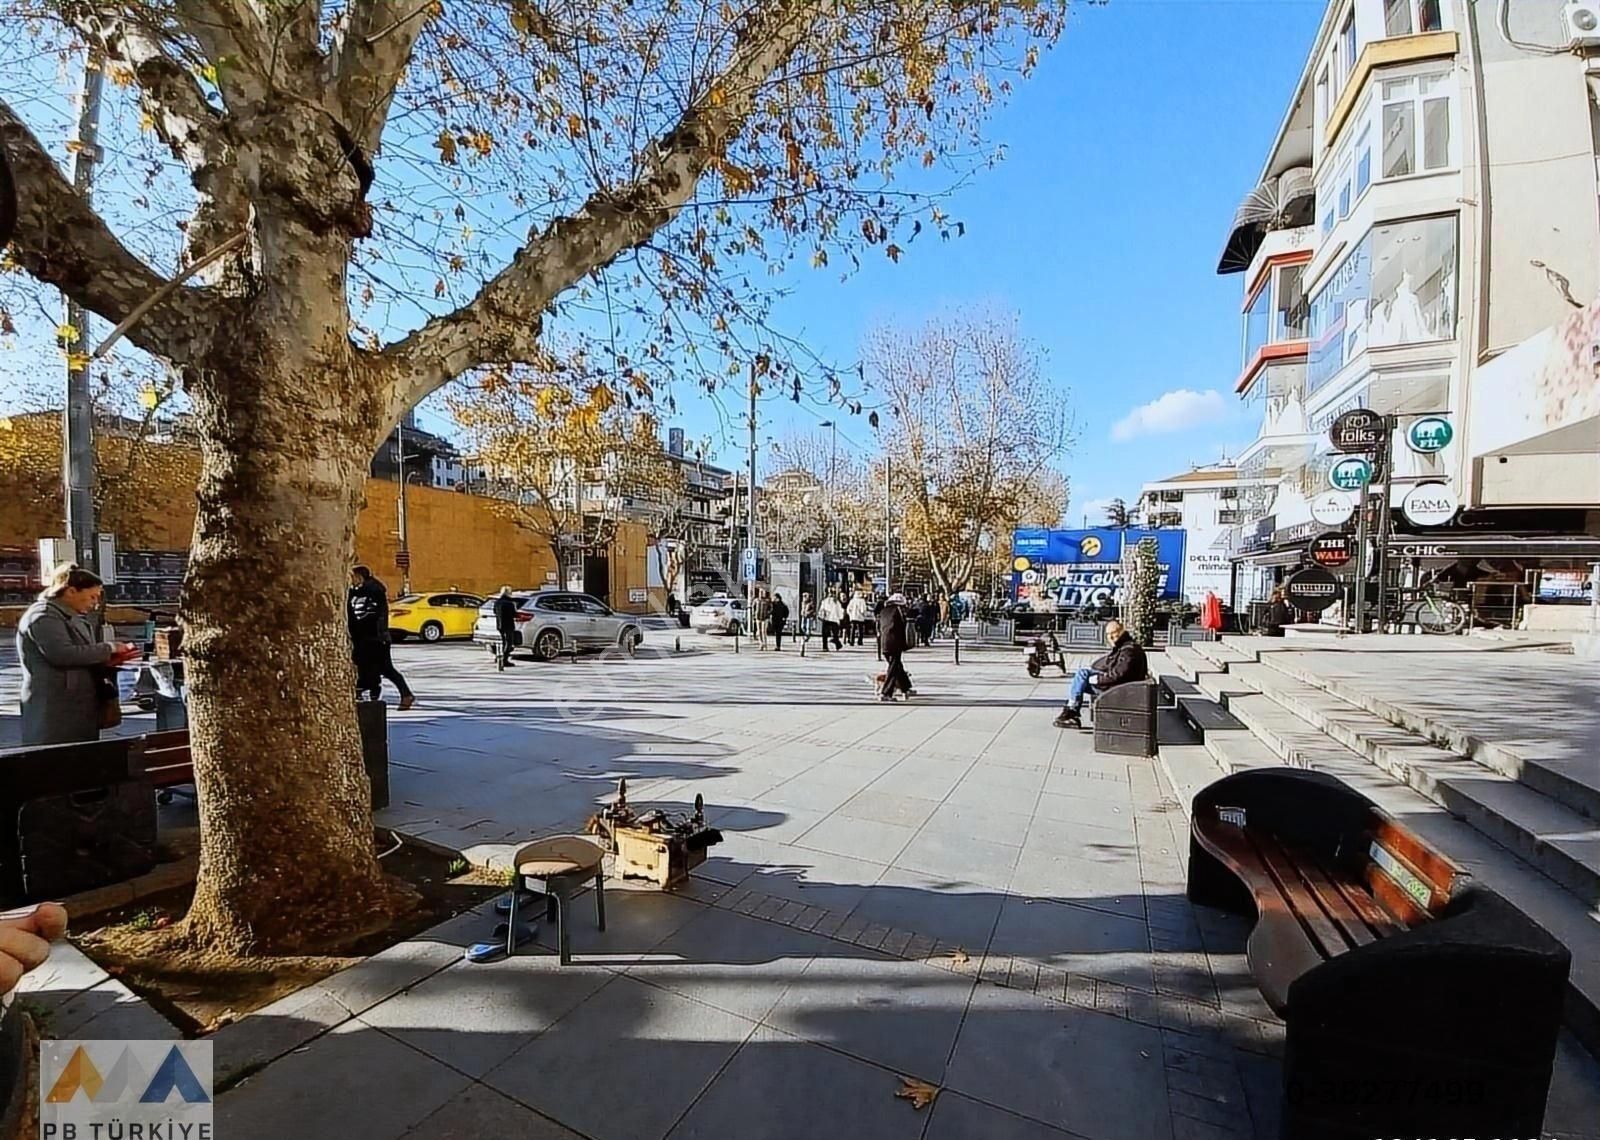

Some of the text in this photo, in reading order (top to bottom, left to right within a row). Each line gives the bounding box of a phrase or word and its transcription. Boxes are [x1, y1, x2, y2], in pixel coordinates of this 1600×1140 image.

[1411, 499, 1451, 510] FAMA
[1318, 539, 1345, 548] THE
[1403, 545, 1446, 555] CHIC
[1315, 551, 1349, 560] WALL
